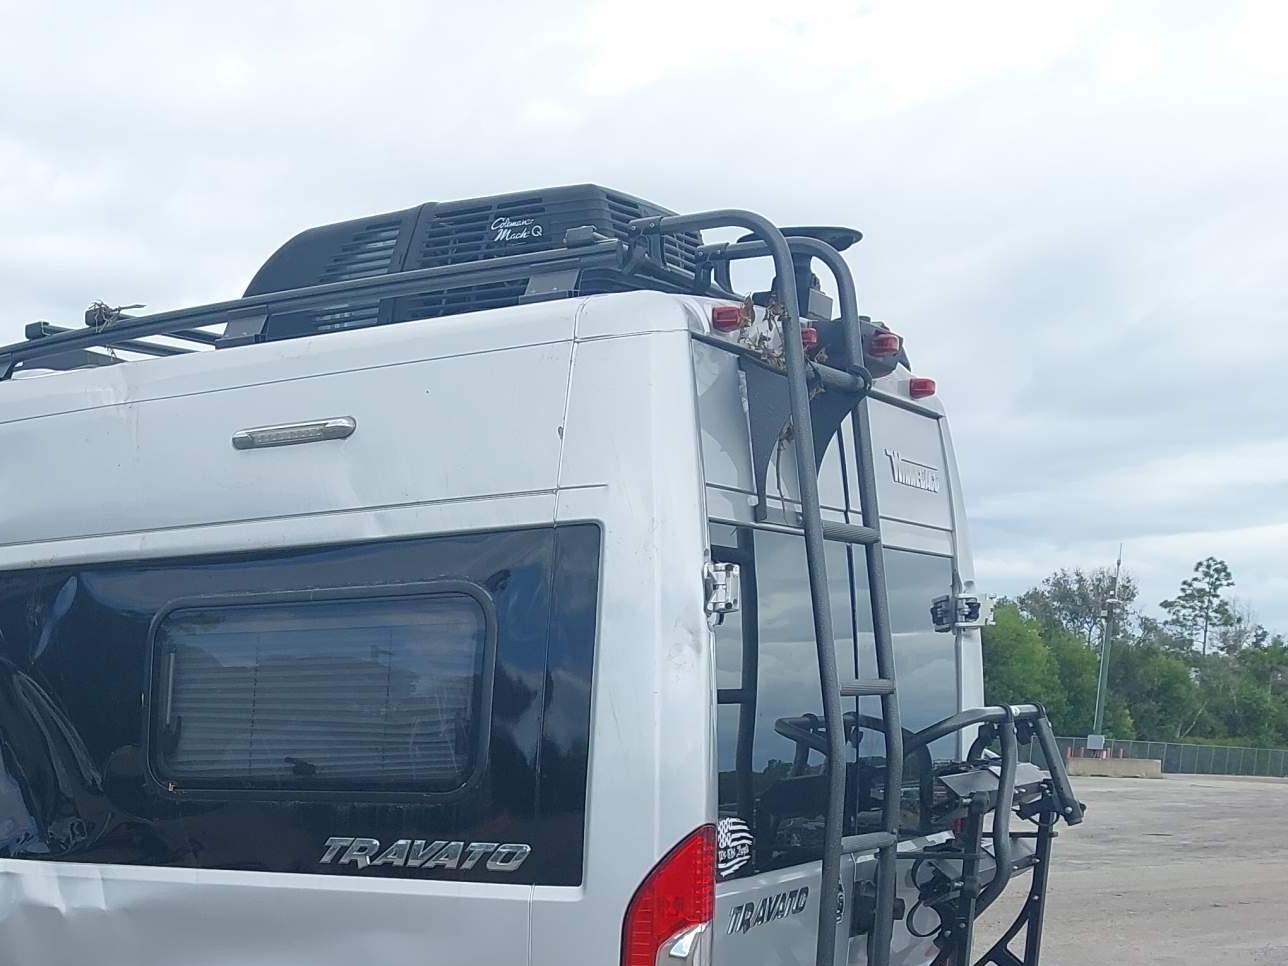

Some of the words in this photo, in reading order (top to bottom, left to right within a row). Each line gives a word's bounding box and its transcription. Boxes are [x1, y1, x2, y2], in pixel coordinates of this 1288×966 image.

[494, 227, 530, 242] Mach
[531, 225, 543, 237] Q
[319, 836, 532, 872] TRAVATO
[726, 886, 810, 935] TRAVATO
